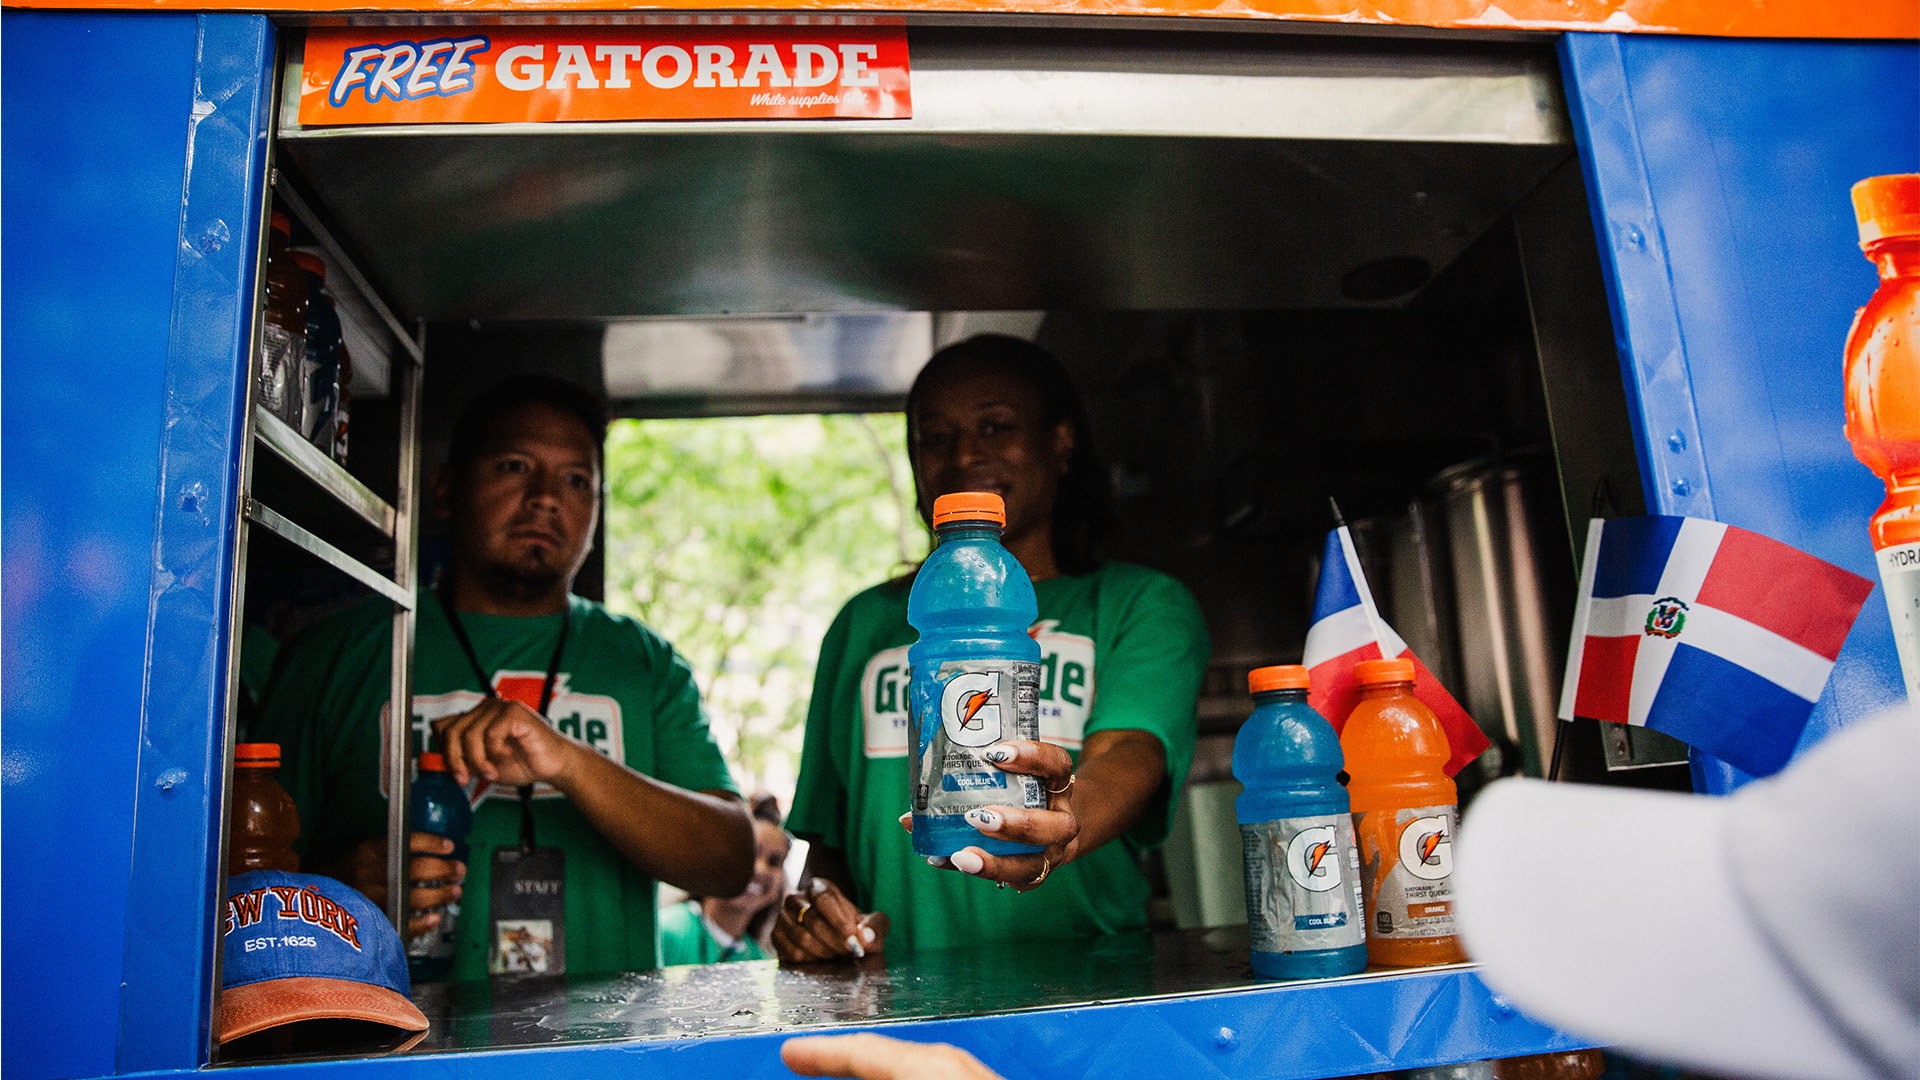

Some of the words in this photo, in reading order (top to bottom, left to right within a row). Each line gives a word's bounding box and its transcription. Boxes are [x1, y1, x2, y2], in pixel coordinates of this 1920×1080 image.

[331, 36, 489, 106] FREE
[495, 45, 878, 92] GATORADE
[750, 92, 787, 106] While
[788, 92, 840, 108] supplies
[941, 671, 1002, 748] G
[941, 760, 965, 769] THIRST
[1286, 825, 1342, 892] G
[244, 936, 317, 952] EST.1625
[268, 885, 362, 952] YORK
